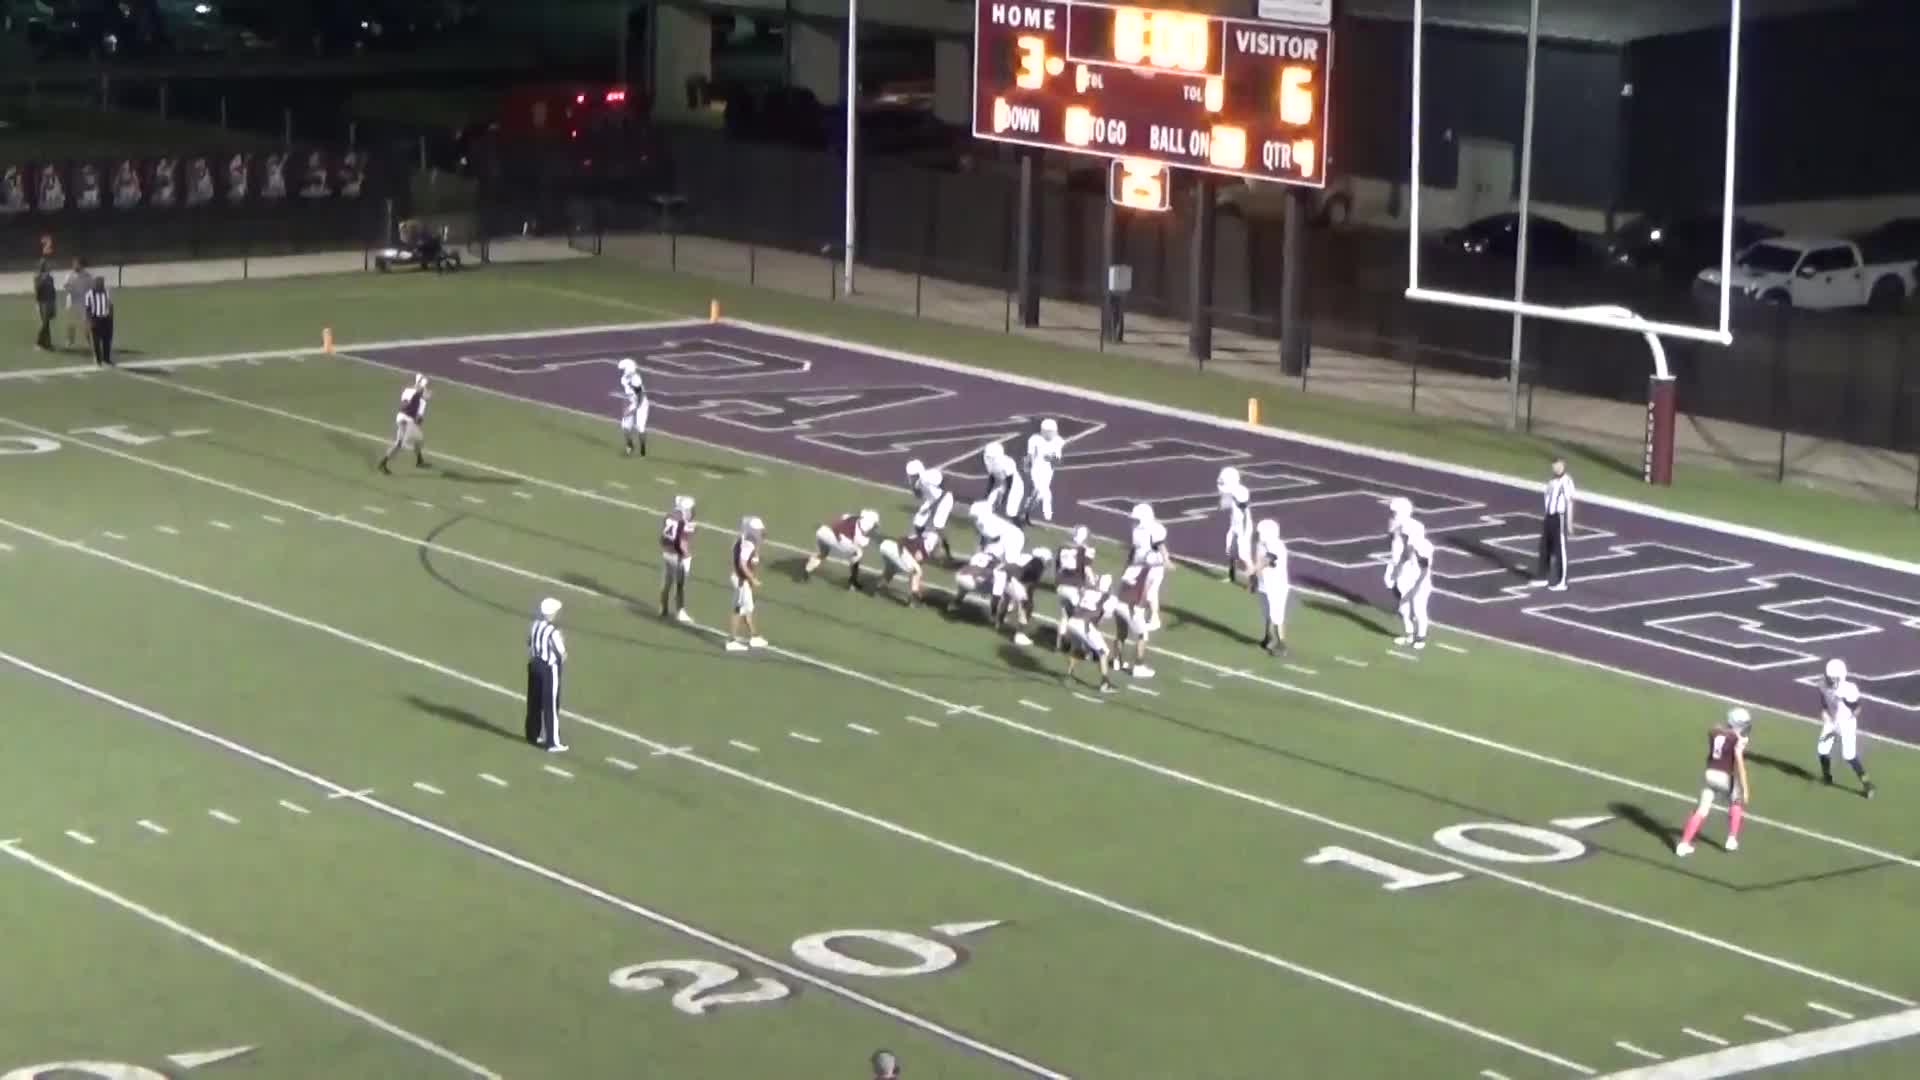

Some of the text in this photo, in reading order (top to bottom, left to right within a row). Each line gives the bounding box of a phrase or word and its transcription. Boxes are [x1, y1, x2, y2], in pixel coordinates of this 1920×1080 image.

[992, 3, 1056, 30] HOME
[1236, 29, 1319, 61] VISITOR
[1016, 36, 1045, 89] 3
[1183, 85, 1203, 102] TOL
[1280, 66, 1313, 125] 6
[1107, 119, 1127, 146] GO
[1150, 125, 1186, 154] BALL
[1189, 129, 1210, 158] ON
[1263, 140, 1291, 170] QTR
[1303, 822, 1586, 890] 10
[609, 929, 957, 1015] 20
